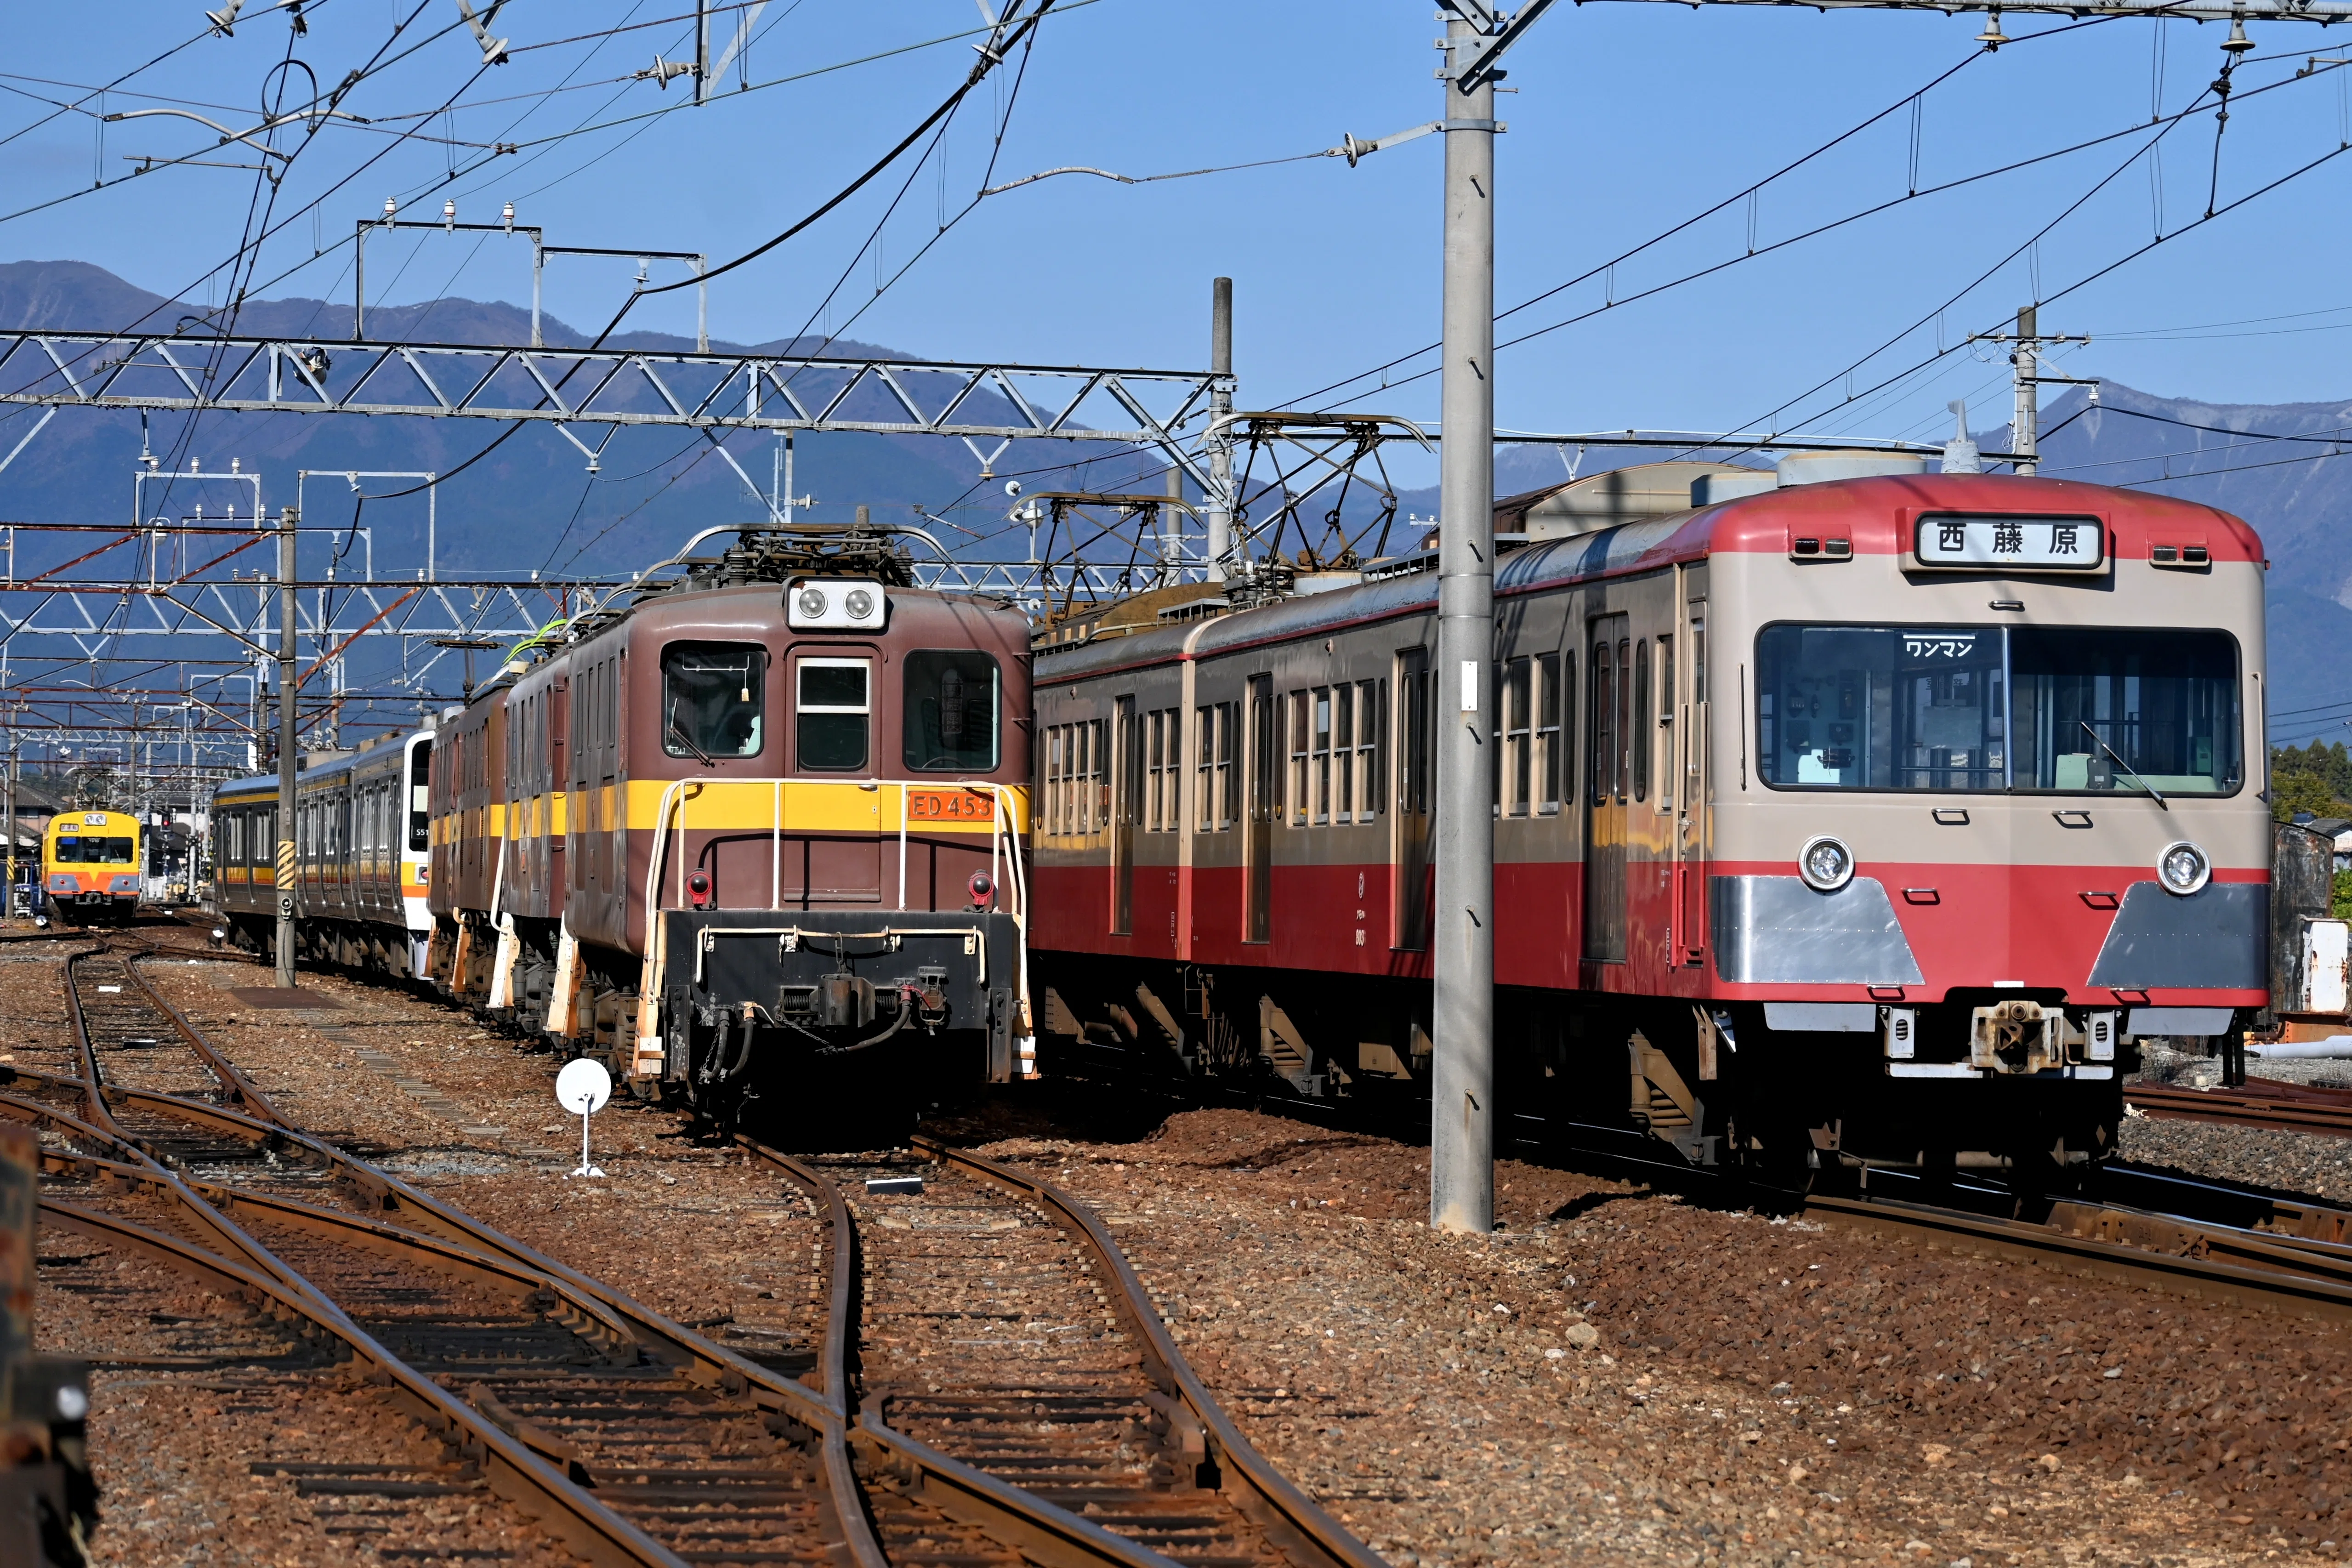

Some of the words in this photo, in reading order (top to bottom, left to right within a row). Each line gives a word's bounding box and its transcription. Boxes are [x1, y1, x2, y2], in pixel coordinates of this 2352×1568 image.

[1937, 522, 2079, 555] 西藤原
[1905, 641, 1973, 658] ワンマン
